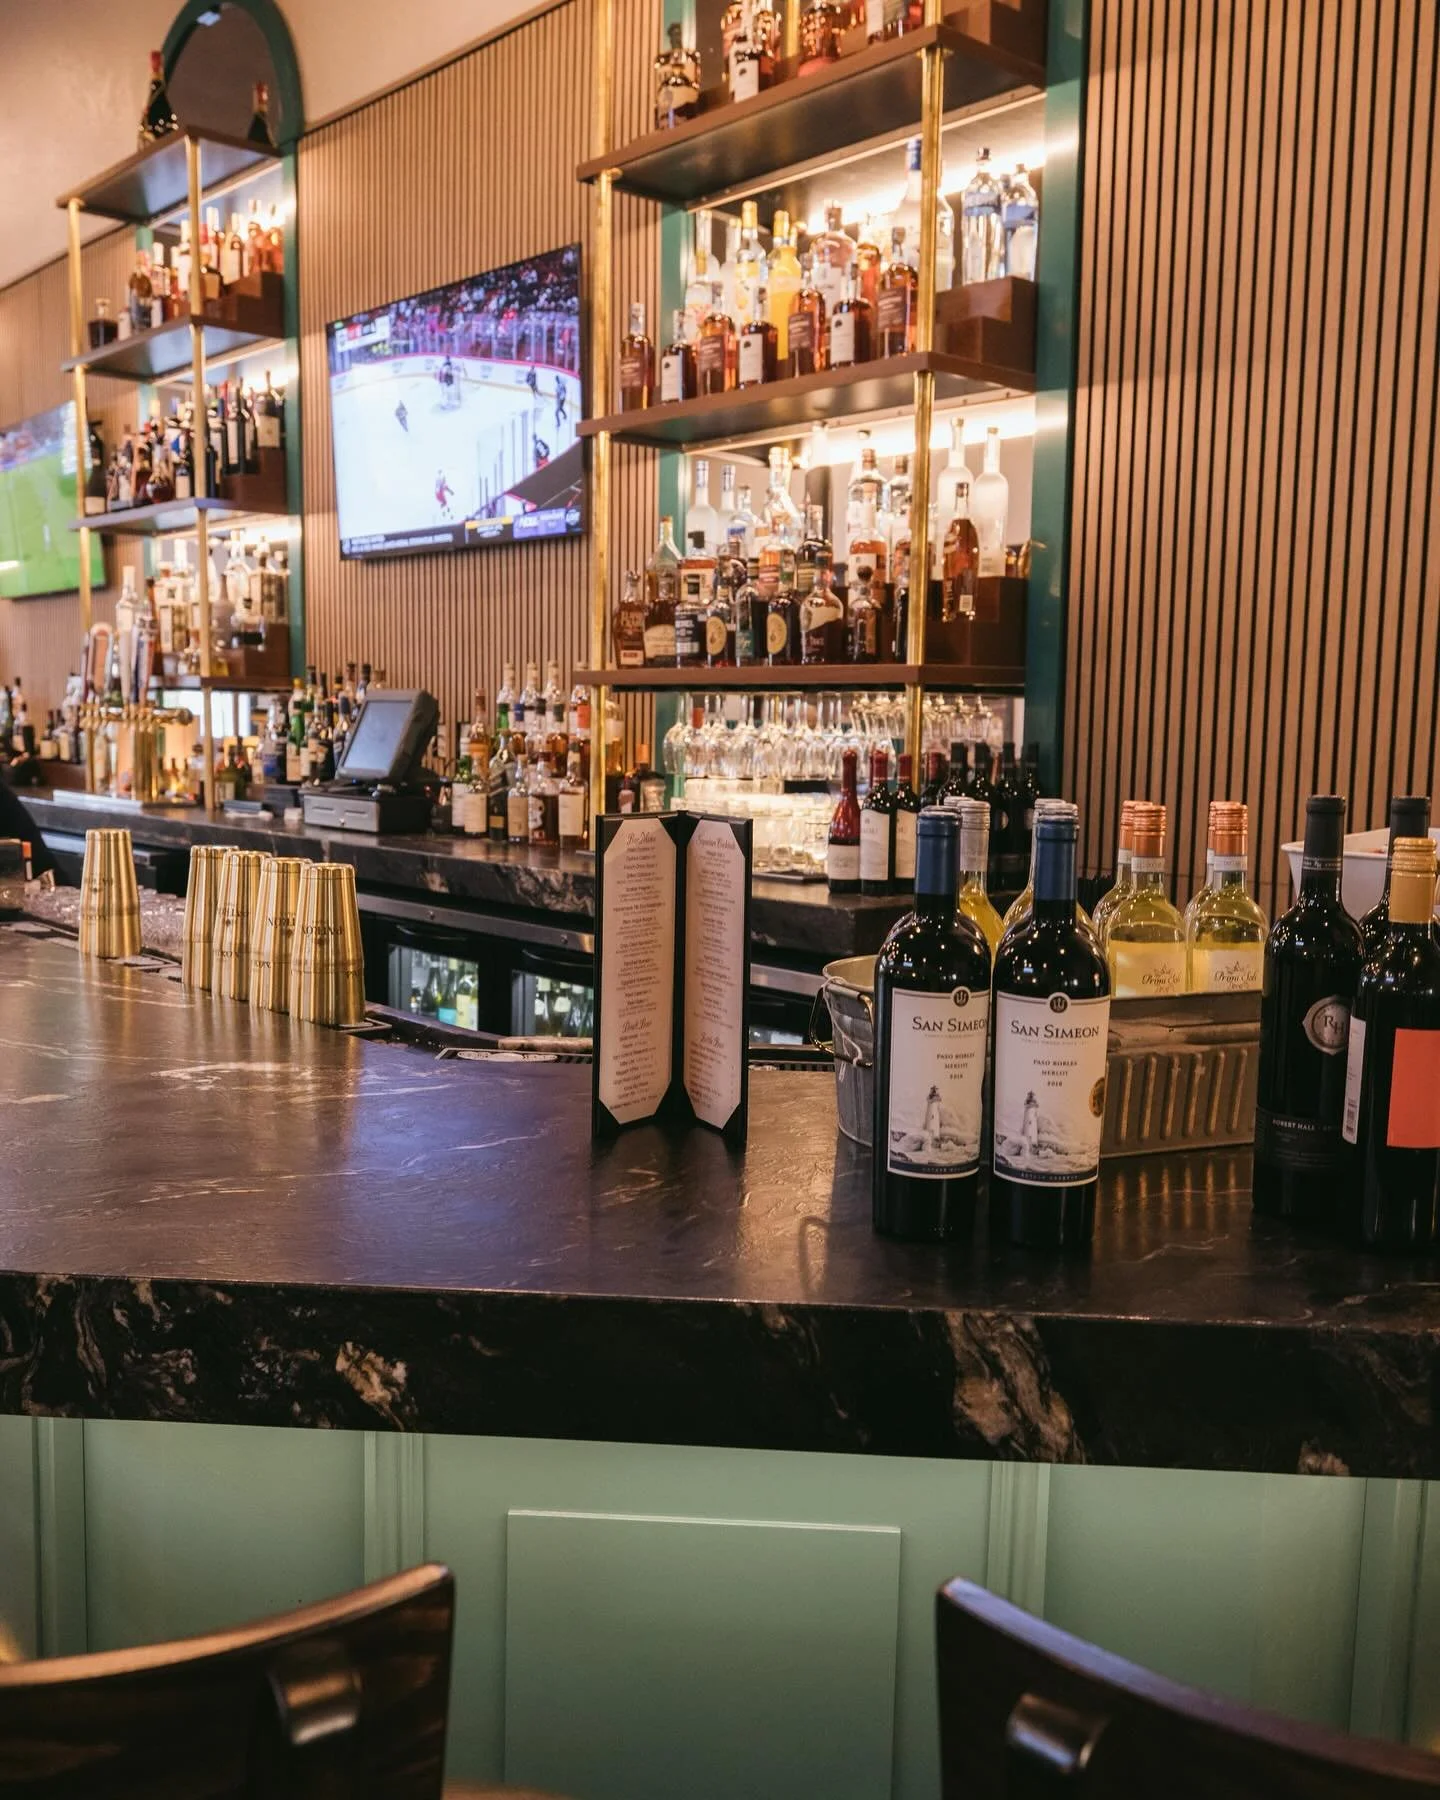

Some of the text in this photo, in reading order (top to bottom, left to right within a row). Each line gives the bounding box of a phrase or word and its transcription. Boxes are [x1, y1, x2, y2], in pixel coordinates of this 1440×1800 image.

[912, 1016, 987, 1032] SAN SIMEO
[1010, 1019, 1100, 1039] SAN SIMEON
